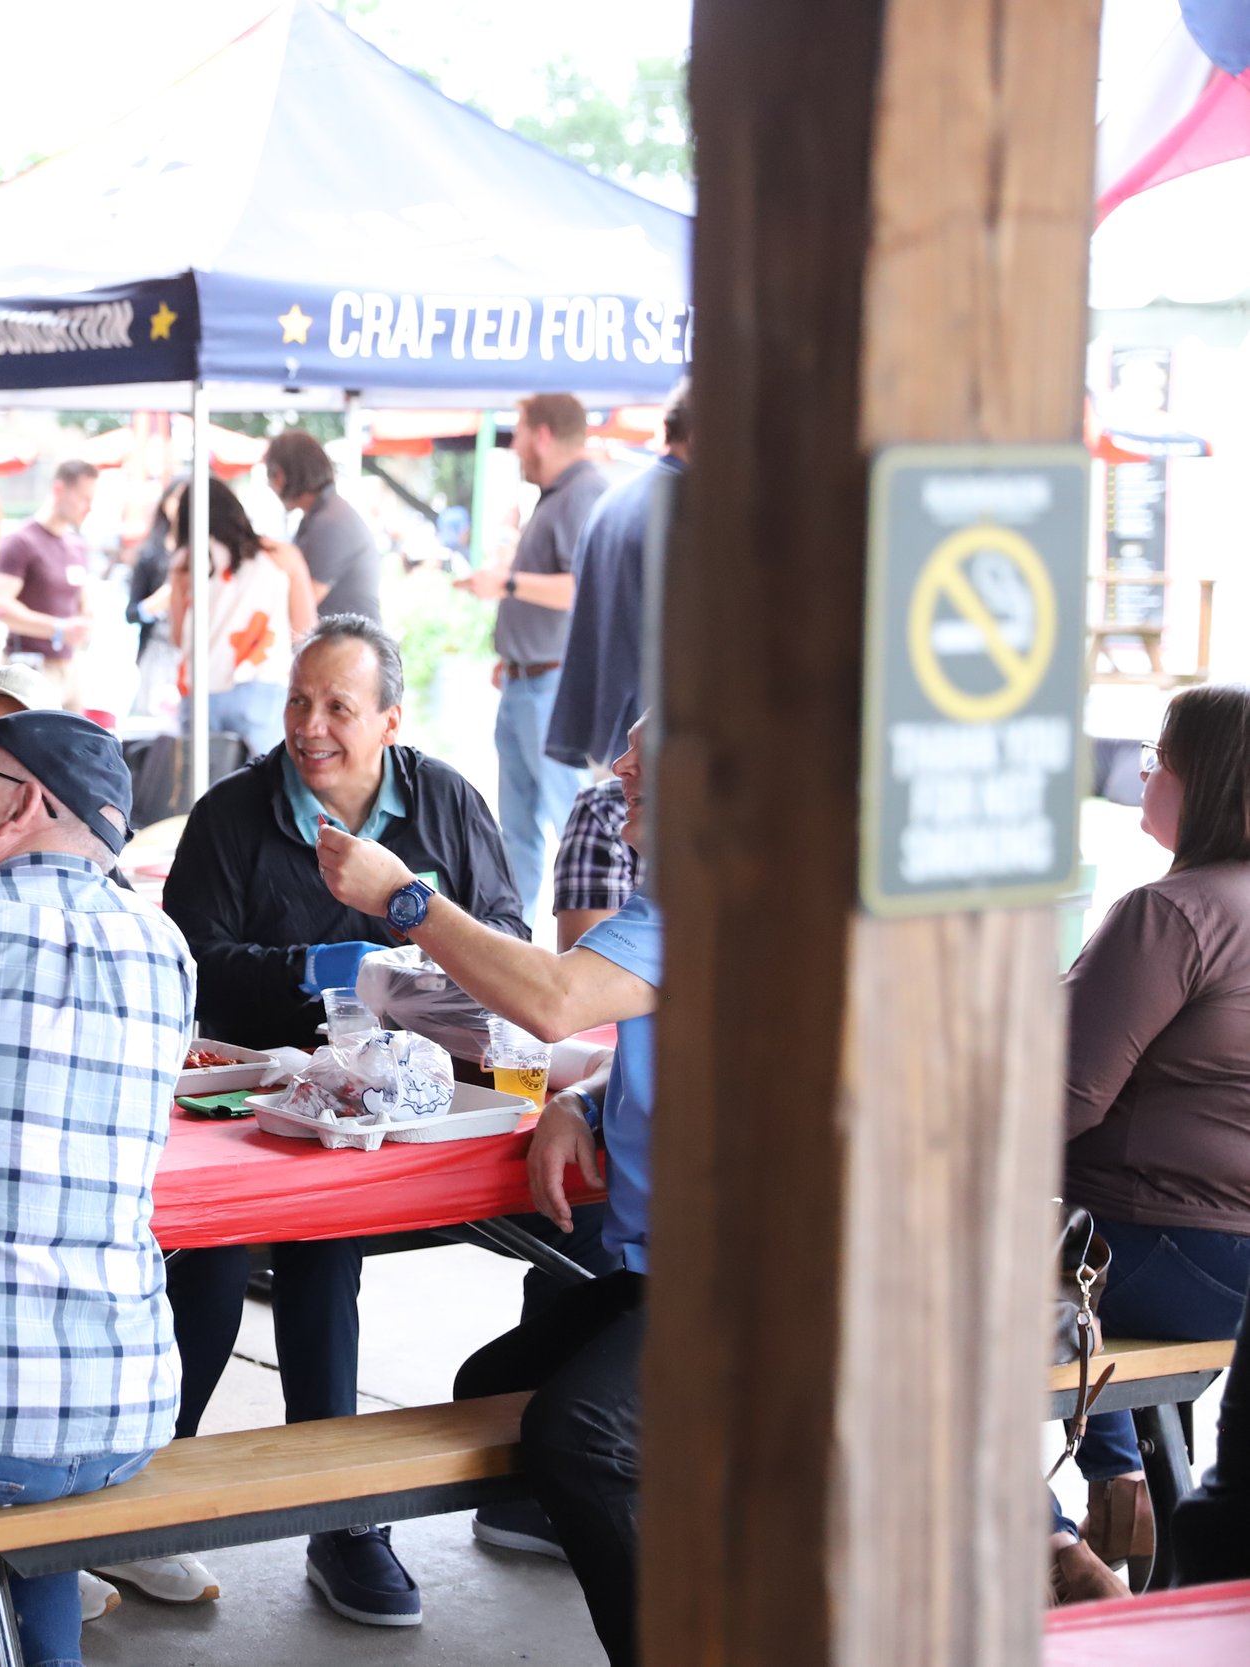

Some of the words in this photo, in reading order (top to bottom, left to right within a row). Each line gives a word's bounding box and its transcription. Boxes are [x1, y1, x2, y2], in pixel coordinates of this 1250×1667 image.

[328, 291, 533, 361] CRAFTED
[539, 296, 627, 362] FOR
[632, 299, 694, 365] SE
